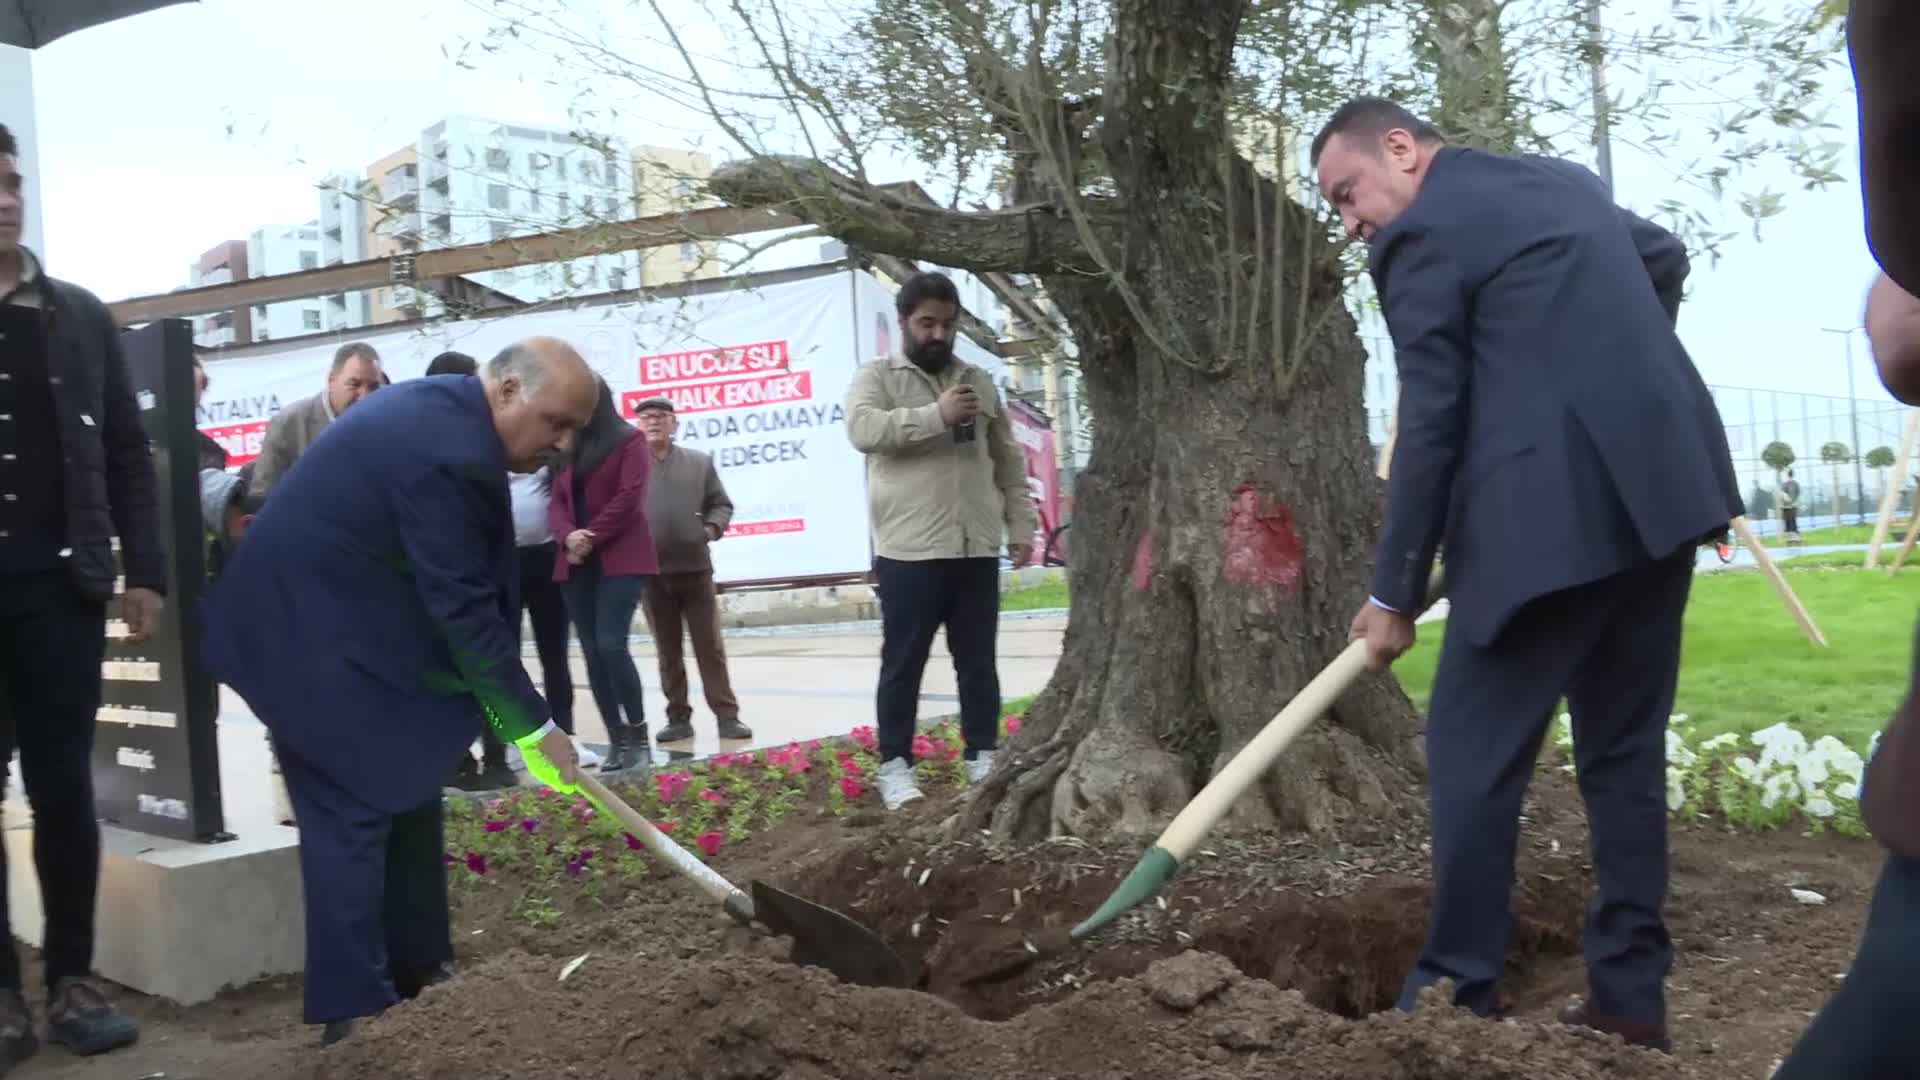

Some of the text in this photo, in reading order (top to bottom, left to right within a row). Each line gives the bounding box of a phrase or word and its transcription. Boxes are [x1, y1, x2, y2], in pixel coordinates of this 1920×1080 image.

[647, 344, 781, 380] EN UCUZ SU
[661, 385, 722, 411] HALK
[723, 375, 803, 406] EKMEK
[682, 404, 845, 440] A'DA OLMAYA
[721, 440, 808, 468] EDECEK
